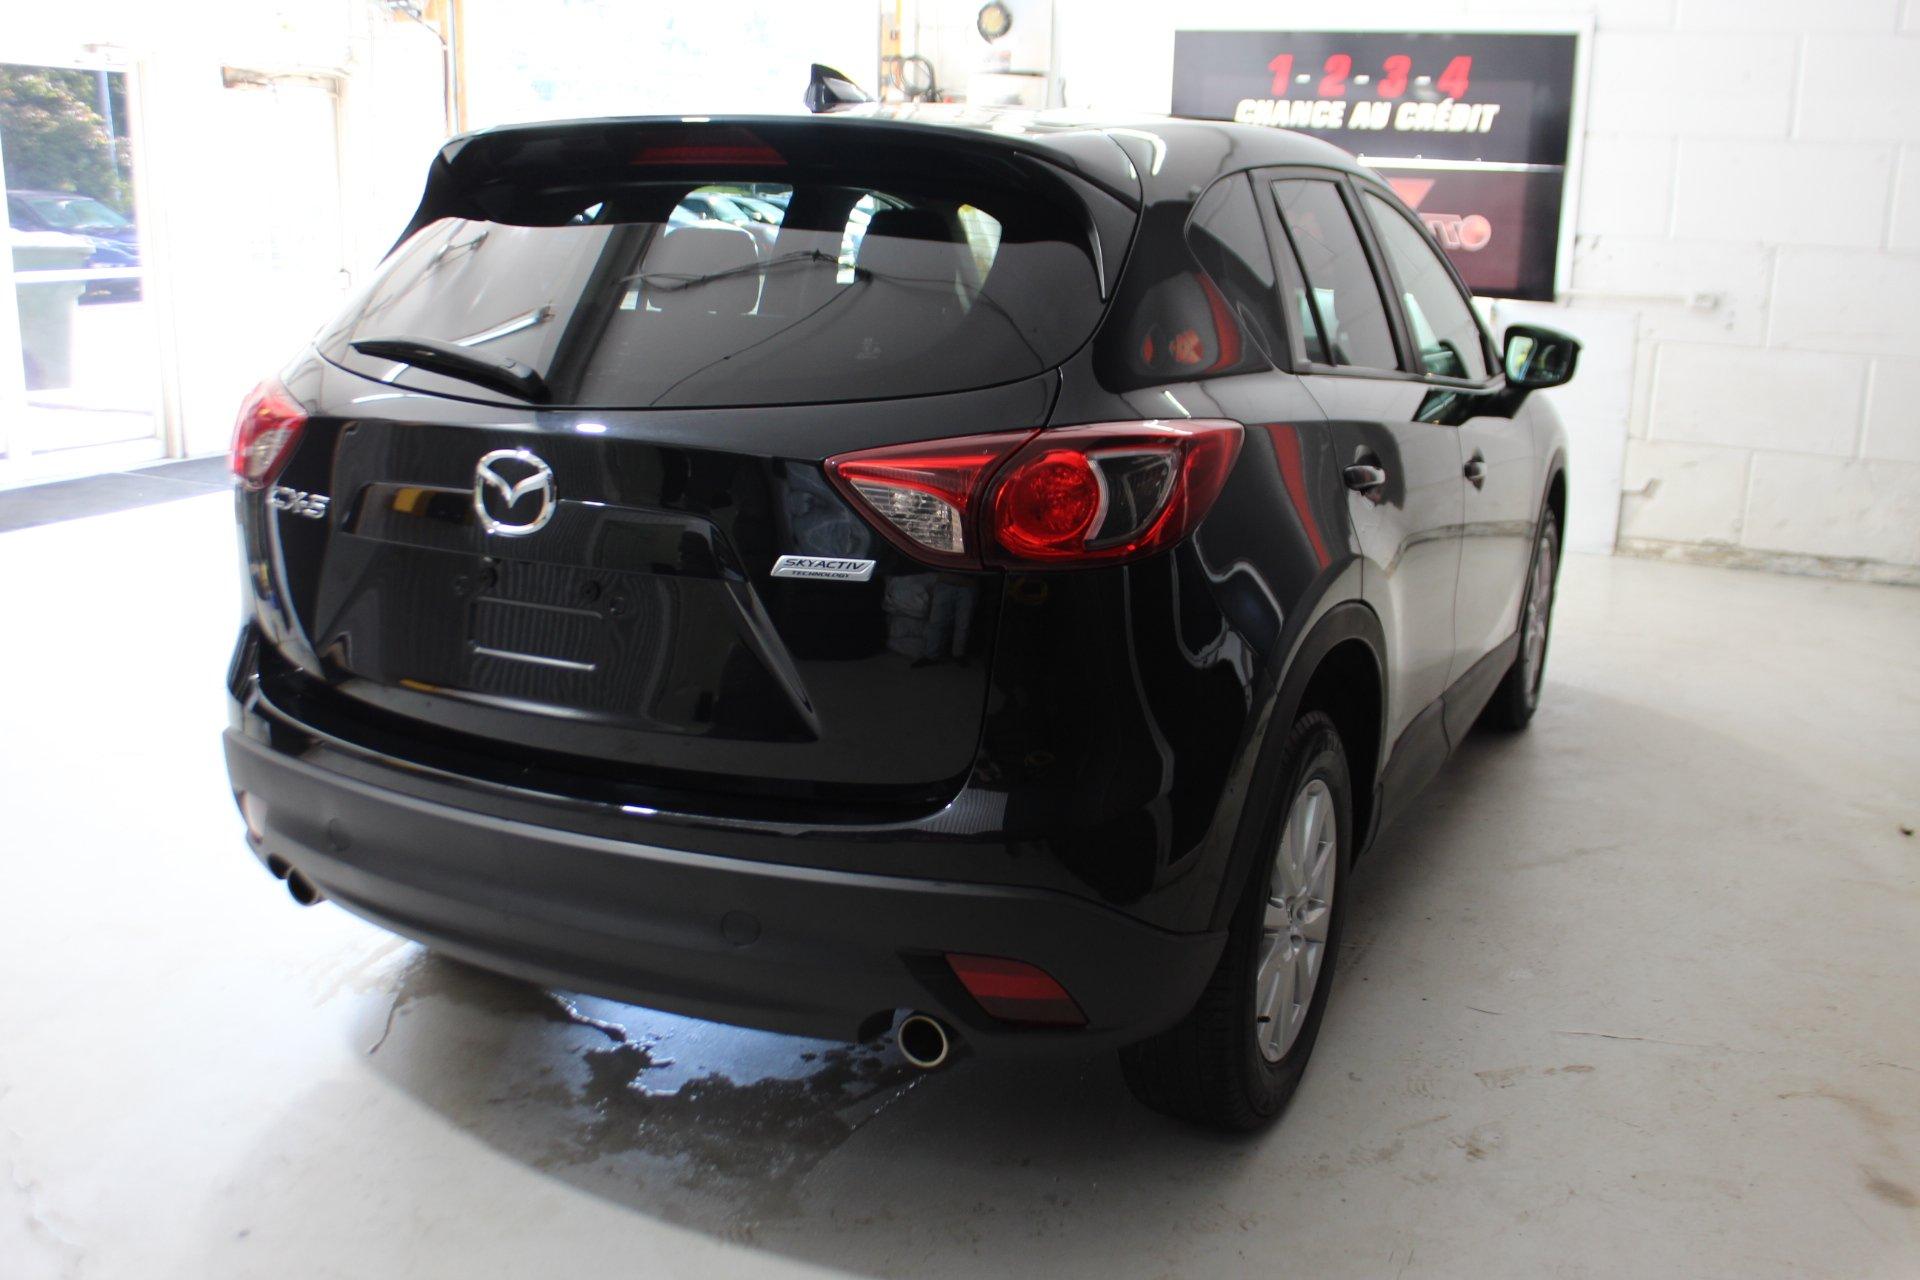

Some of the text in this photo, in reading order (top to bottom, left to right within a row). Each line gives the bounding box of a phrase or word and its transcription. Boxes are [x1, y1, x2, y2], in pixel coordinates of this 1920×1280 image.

[1234, 98, 1500, 133] CHANCE AU CRÉDIT
[783, 558, 865, 570] SKYACTIV
[791, 570, 850, 579] TECHNOLOGY
